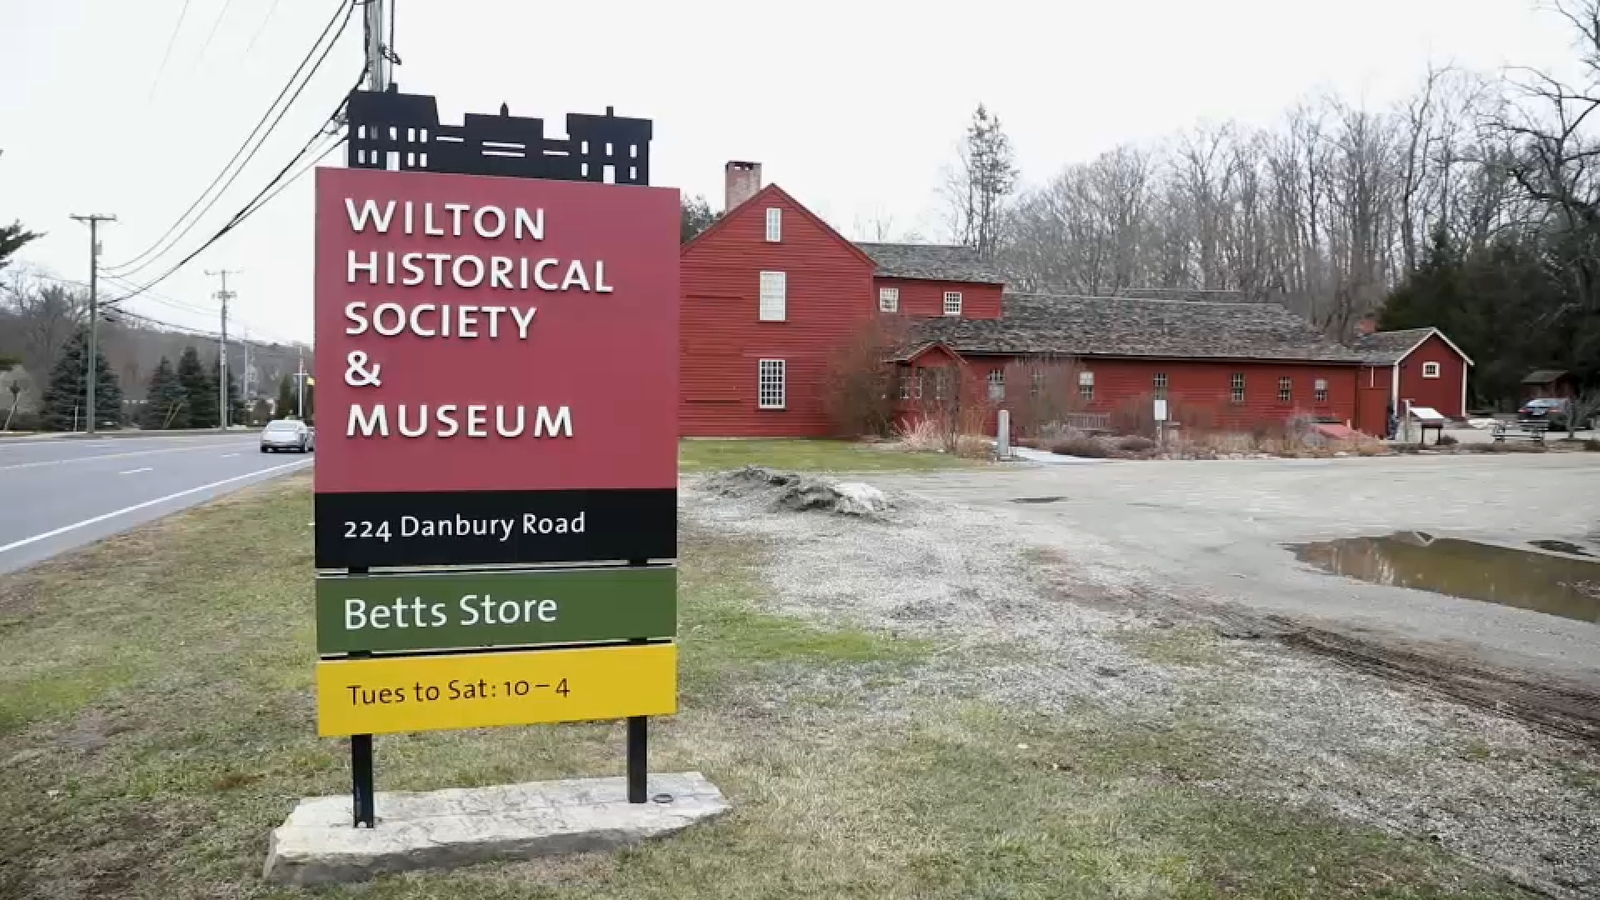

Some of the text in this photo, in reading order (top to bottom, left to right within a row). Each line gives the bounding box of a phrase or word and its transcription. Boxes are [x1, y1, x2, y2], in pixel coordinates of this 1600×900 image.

[345, 198, 545, 241] WILTON
[346, 250, 614, 293] HISTORICAL
[345, 301, 538, 340] SOCIETY
[344, 350, 381, 388] &
[346, 404, 574, 438] MUSEUM
[344, 511, 586, 542] 224 Danbury Road
[345, 594, 558, 629] Betts Store
[347, 685, 404, 706] Tues
[415, 682, 439, 701] to
[449, 679, 496, 699] Sat:
